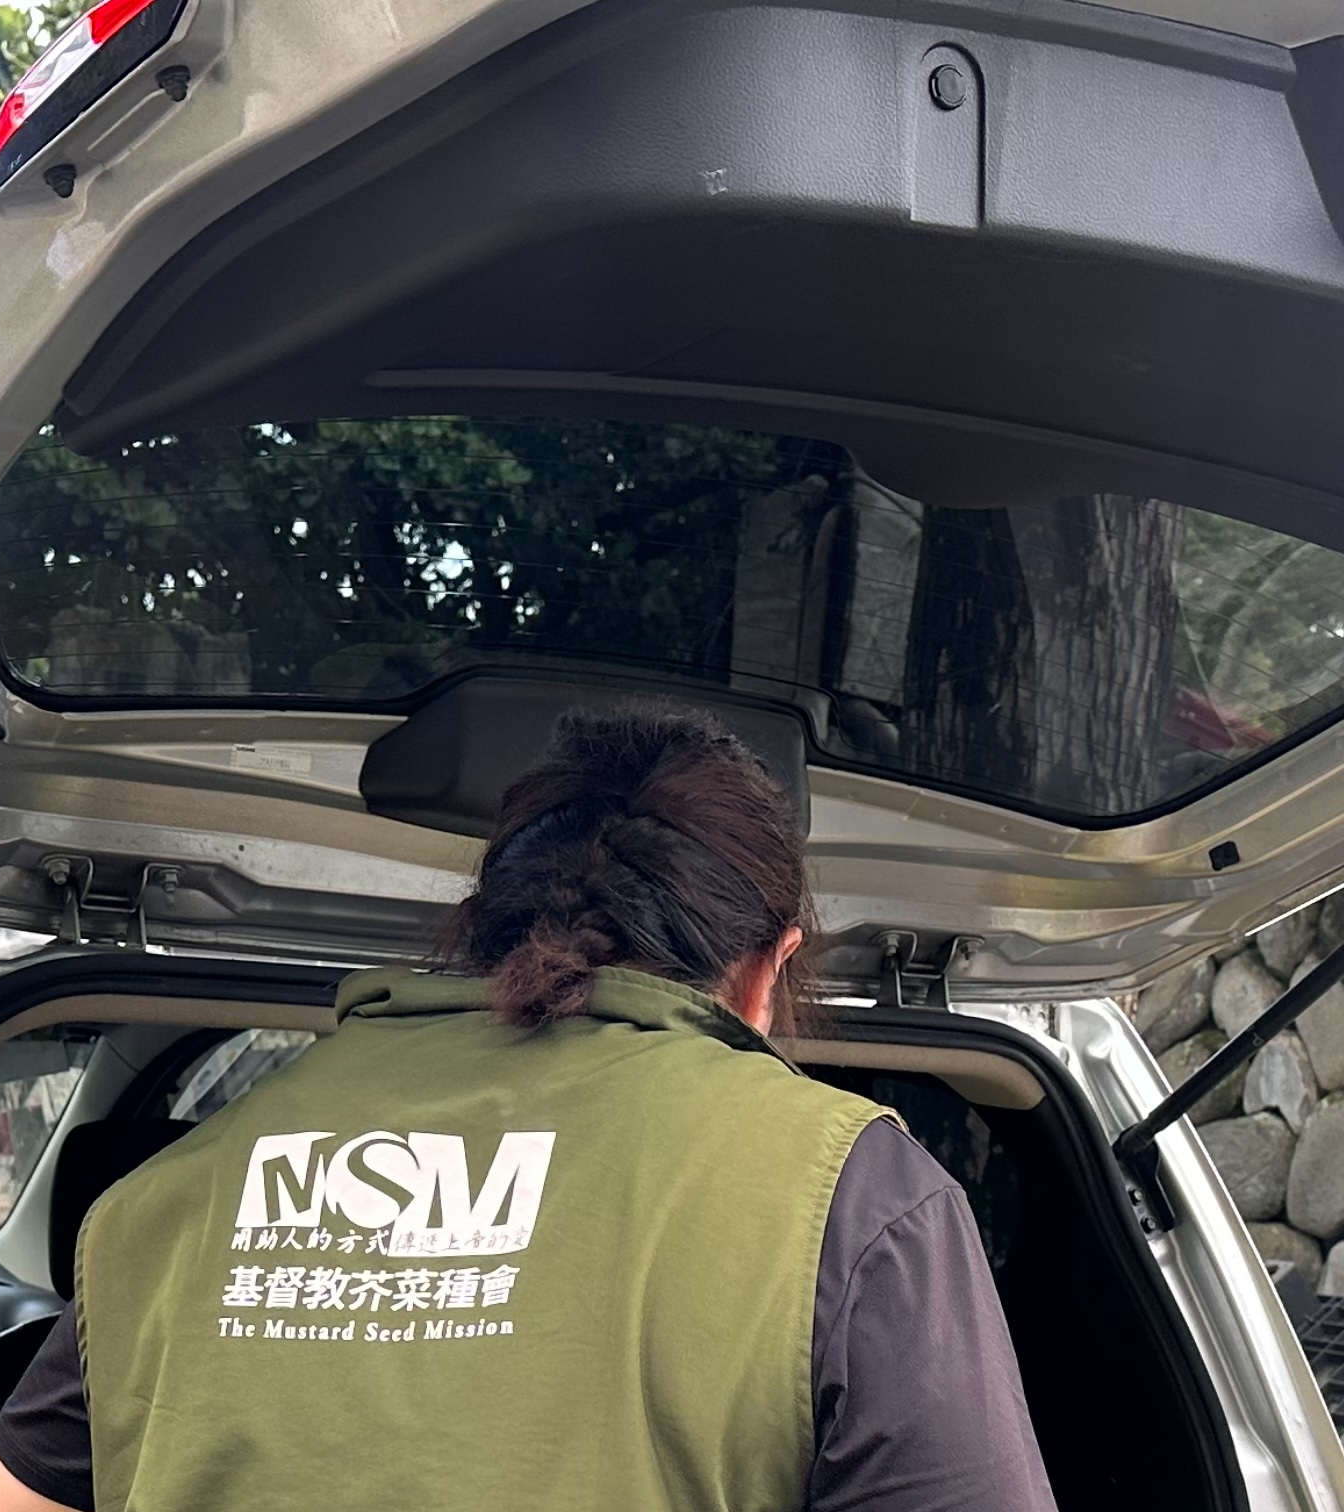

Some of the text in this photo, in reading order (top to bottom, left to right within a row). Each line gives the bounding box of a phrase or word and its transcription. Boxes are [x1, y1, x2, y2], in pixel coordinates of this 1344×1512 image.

[222, 1264, 520, 1311] 基督教芥菜種會
[218, 1317, 514, 1342] The Mustard Seed Mission
